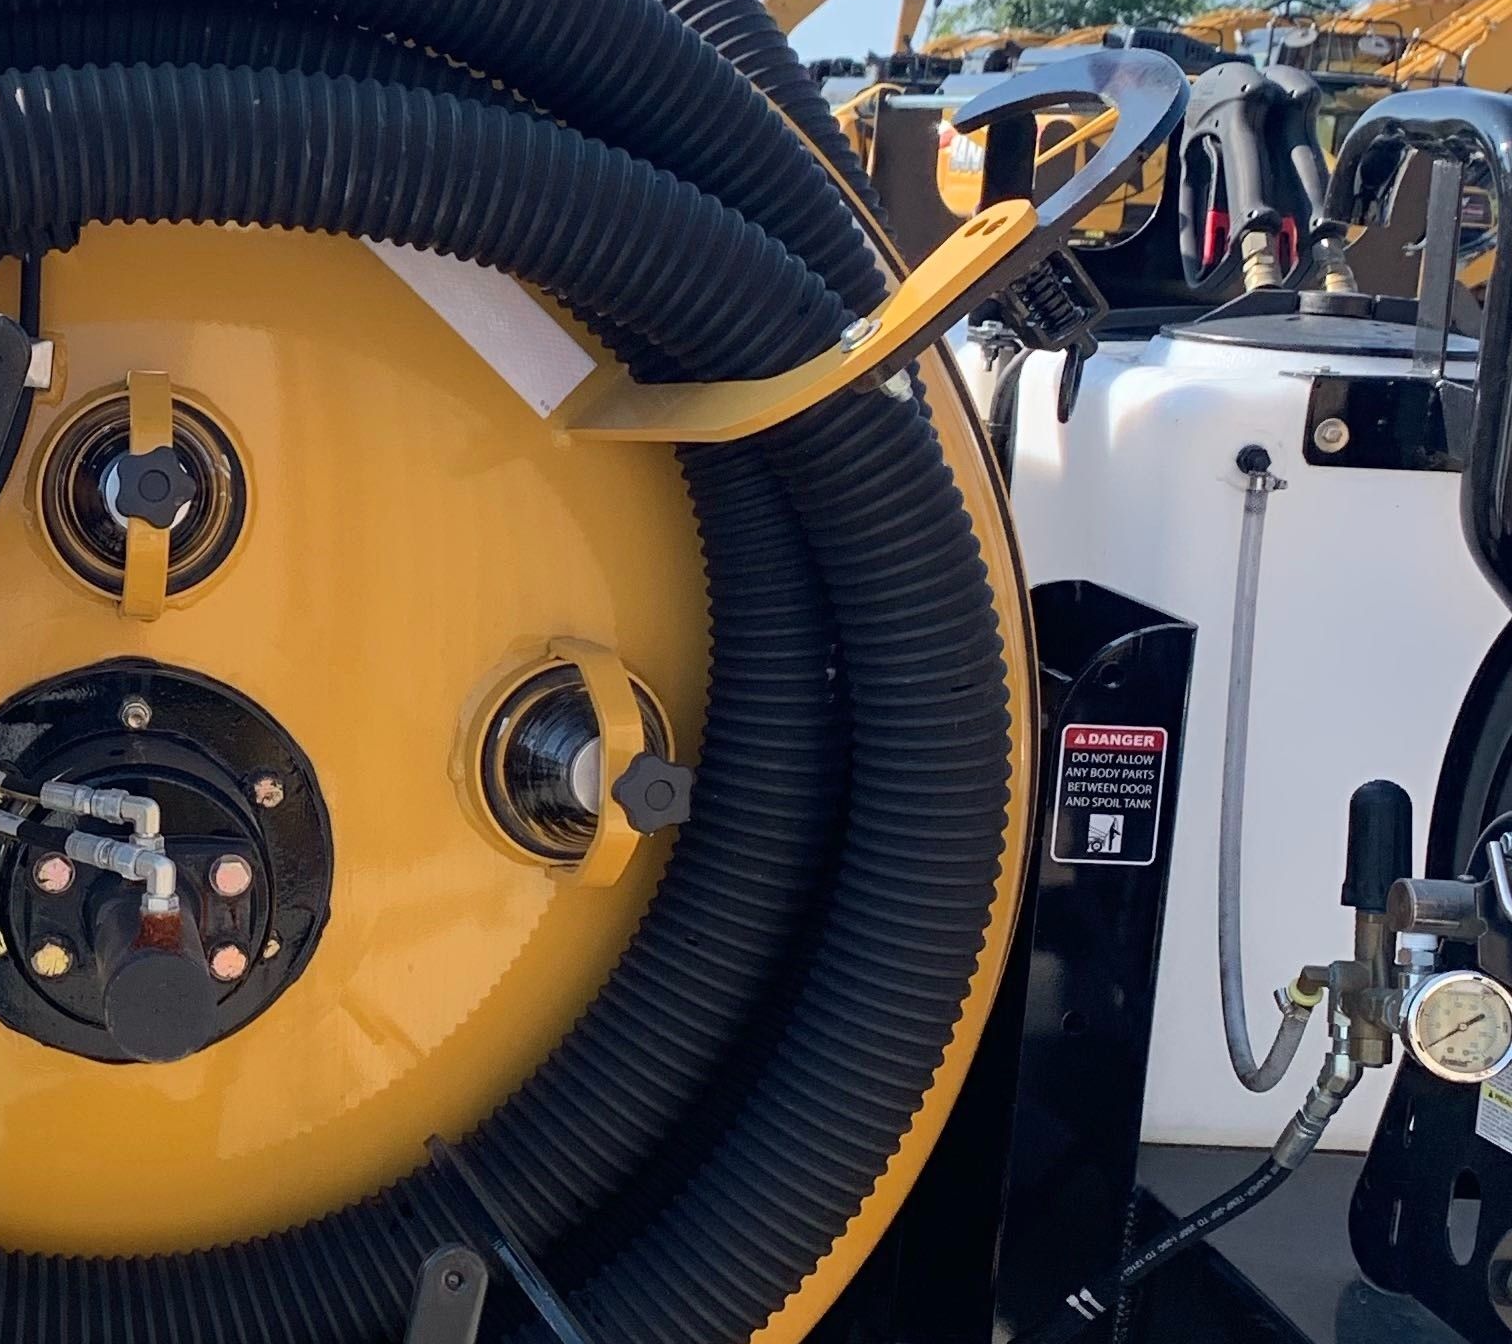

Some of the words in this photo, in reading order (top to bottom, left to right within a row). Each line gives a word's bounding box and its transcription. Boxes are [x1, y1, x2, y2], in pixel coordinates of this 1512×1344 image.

[1088, 733, 1155, 747] DANGER
[1071, 752, 1089, 763] DO
[1091, 753, 1115, 764] NOT
[1115, 754, 1154, 765] ALLOW
[1065, 767, 1088, 777] ANY
[1089, 767, 1121, 778] BODY
[1121, 769, 1155, 780] PARTS
[1067, 781, 1118, 793] BETWEEN
[1119, 783, 1152, 794] DOOR
[1065, 796, 1090, 807] AND
[1091, 797, 1122, 808] SPOIL
[1124, 798, 1152, 809] TANK
